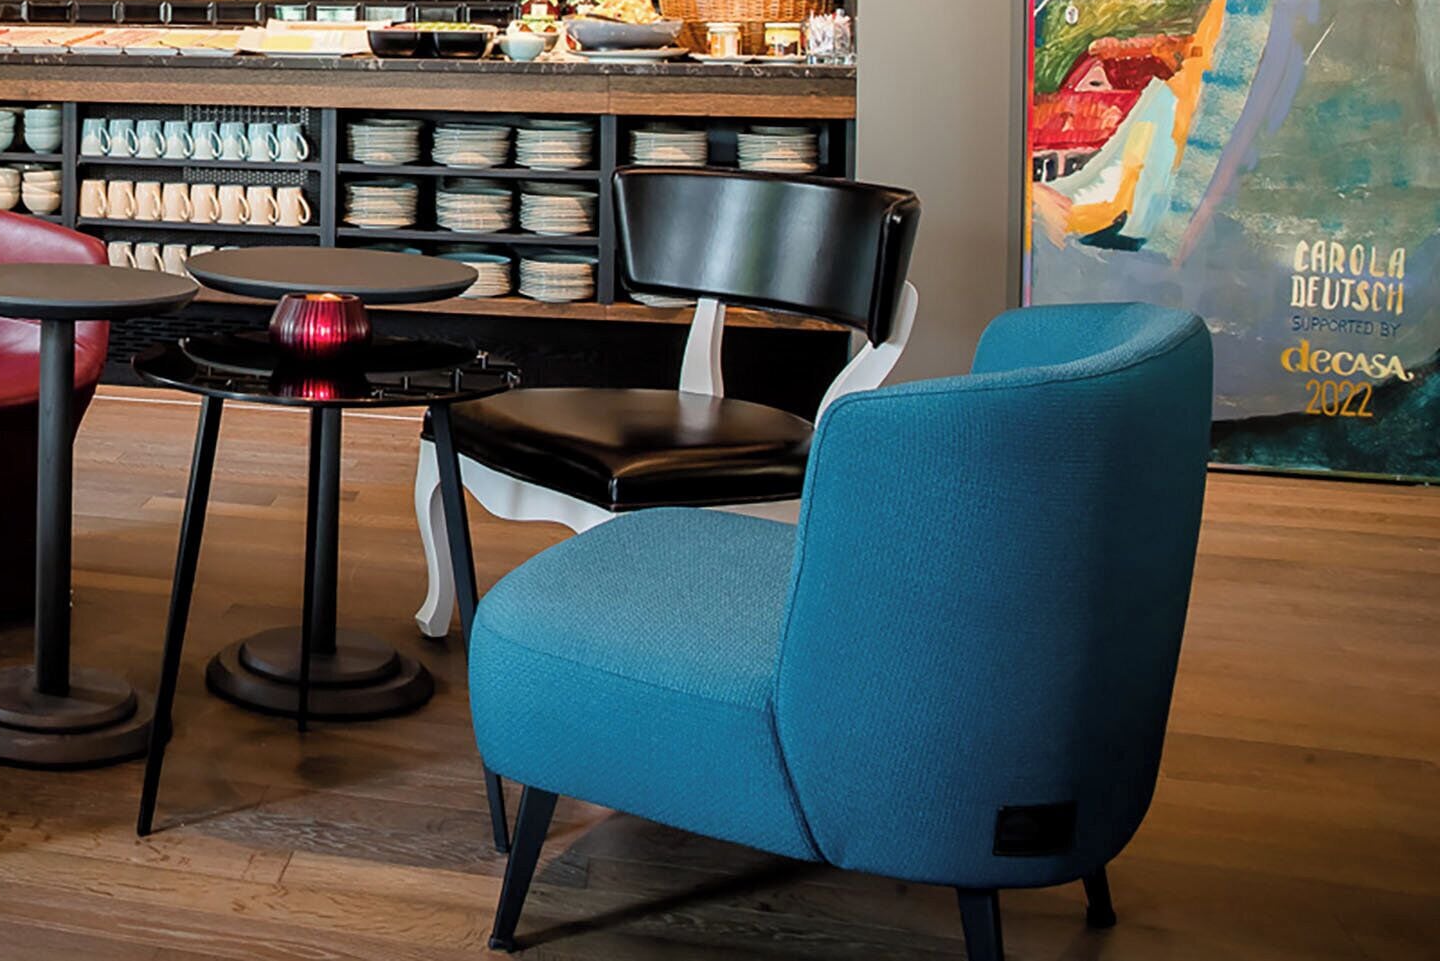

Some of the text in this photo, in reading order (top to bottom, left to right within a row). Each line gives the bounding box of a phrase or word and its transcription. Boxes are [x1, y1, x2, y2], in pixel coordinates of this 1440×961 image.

[1294, 239, 1406, 279] CAROLA
[1290, 274, 1404, 316] DEUTSCH
[1291, 315, 1402, 337] SUPPORTED BY
[1305, 379, 1373, 418] 2022
